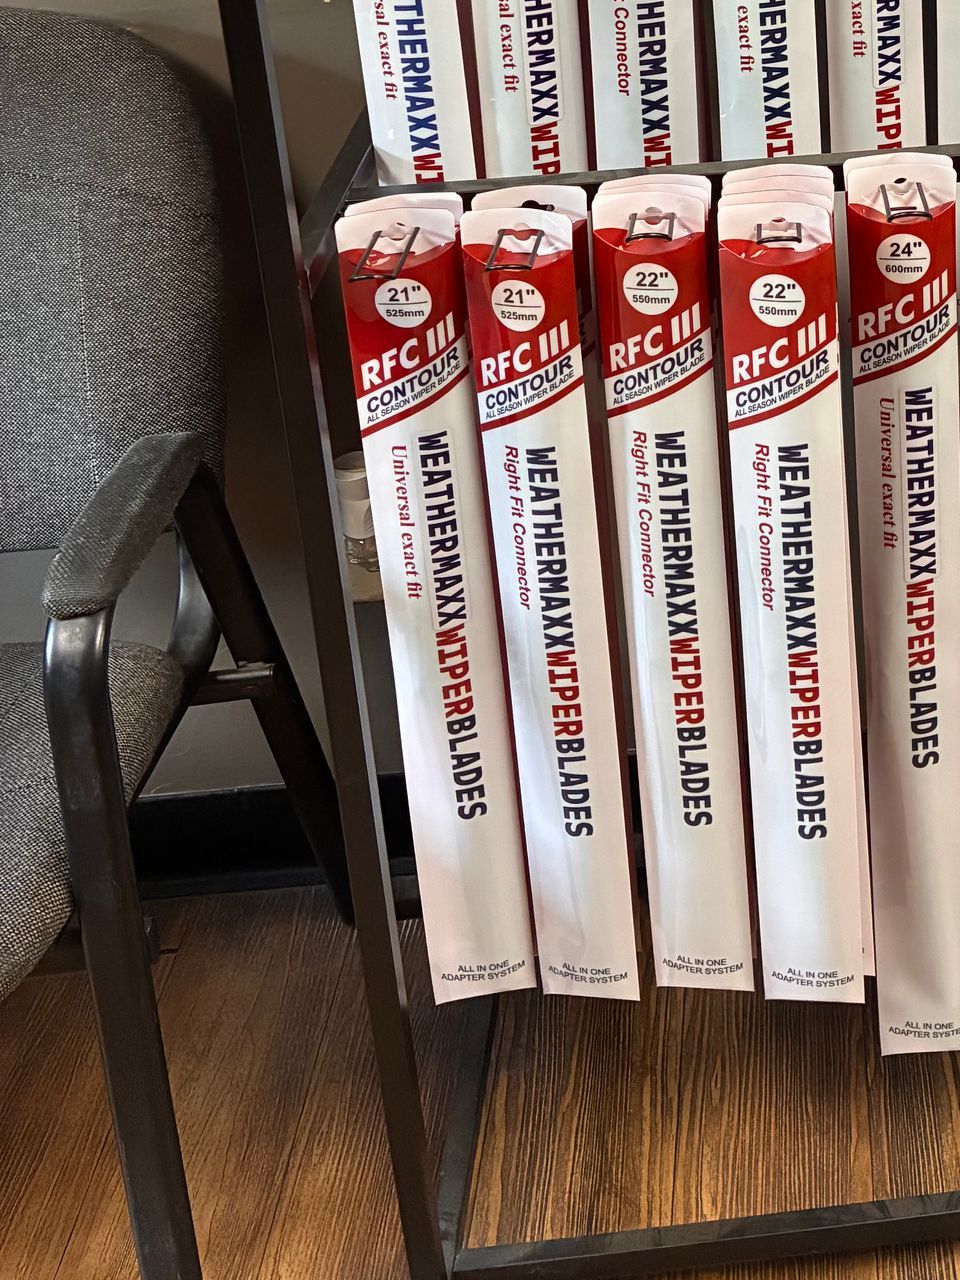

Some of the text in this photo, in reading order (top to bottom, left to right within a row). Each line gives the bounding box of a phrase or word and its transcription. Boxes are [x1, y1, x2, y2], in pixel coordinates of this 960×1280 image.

[500, 24, 517, 69] exact
[614, 8, 631, 96] Connector
[504, 75, 519, 92] fit
[890, 241, 921, 257] 24"
[885, 264, 922, 273] 600mm
[636, 271, 668, 287] 22"
[388, 285, 420, 302] 21"
[504, 288, 534, 304] 21"
[633, 295, 670, 303] 550mm
[763, 283, 796, 298] 22"
[386, 309, 424, 317] 525mm
[501, 310, 537, 320] 525mm
[759, 306, 796, 315] 550mm
[861, 305, 950, 364] CONTOUR
[360, 312, 455, 391] RFC III
[732, 313, 826, 384] RFC III
[613, 337, 703, 395] CONTOUR
[367, 346, 459, 413] CONTOUR
[485, 354, 573, 409] CONTOUR
[736, 349, 829, 408] CONTOUR
[391, 445, 422, 599] Universal exact fit
[753, 443, 775, 611] Right Fit Connector
[772, 972, 854, 987] ADAPTER SYSTEM
[787, 968, 803, 977] ALL
[818, 971, 838, 979] ONE
